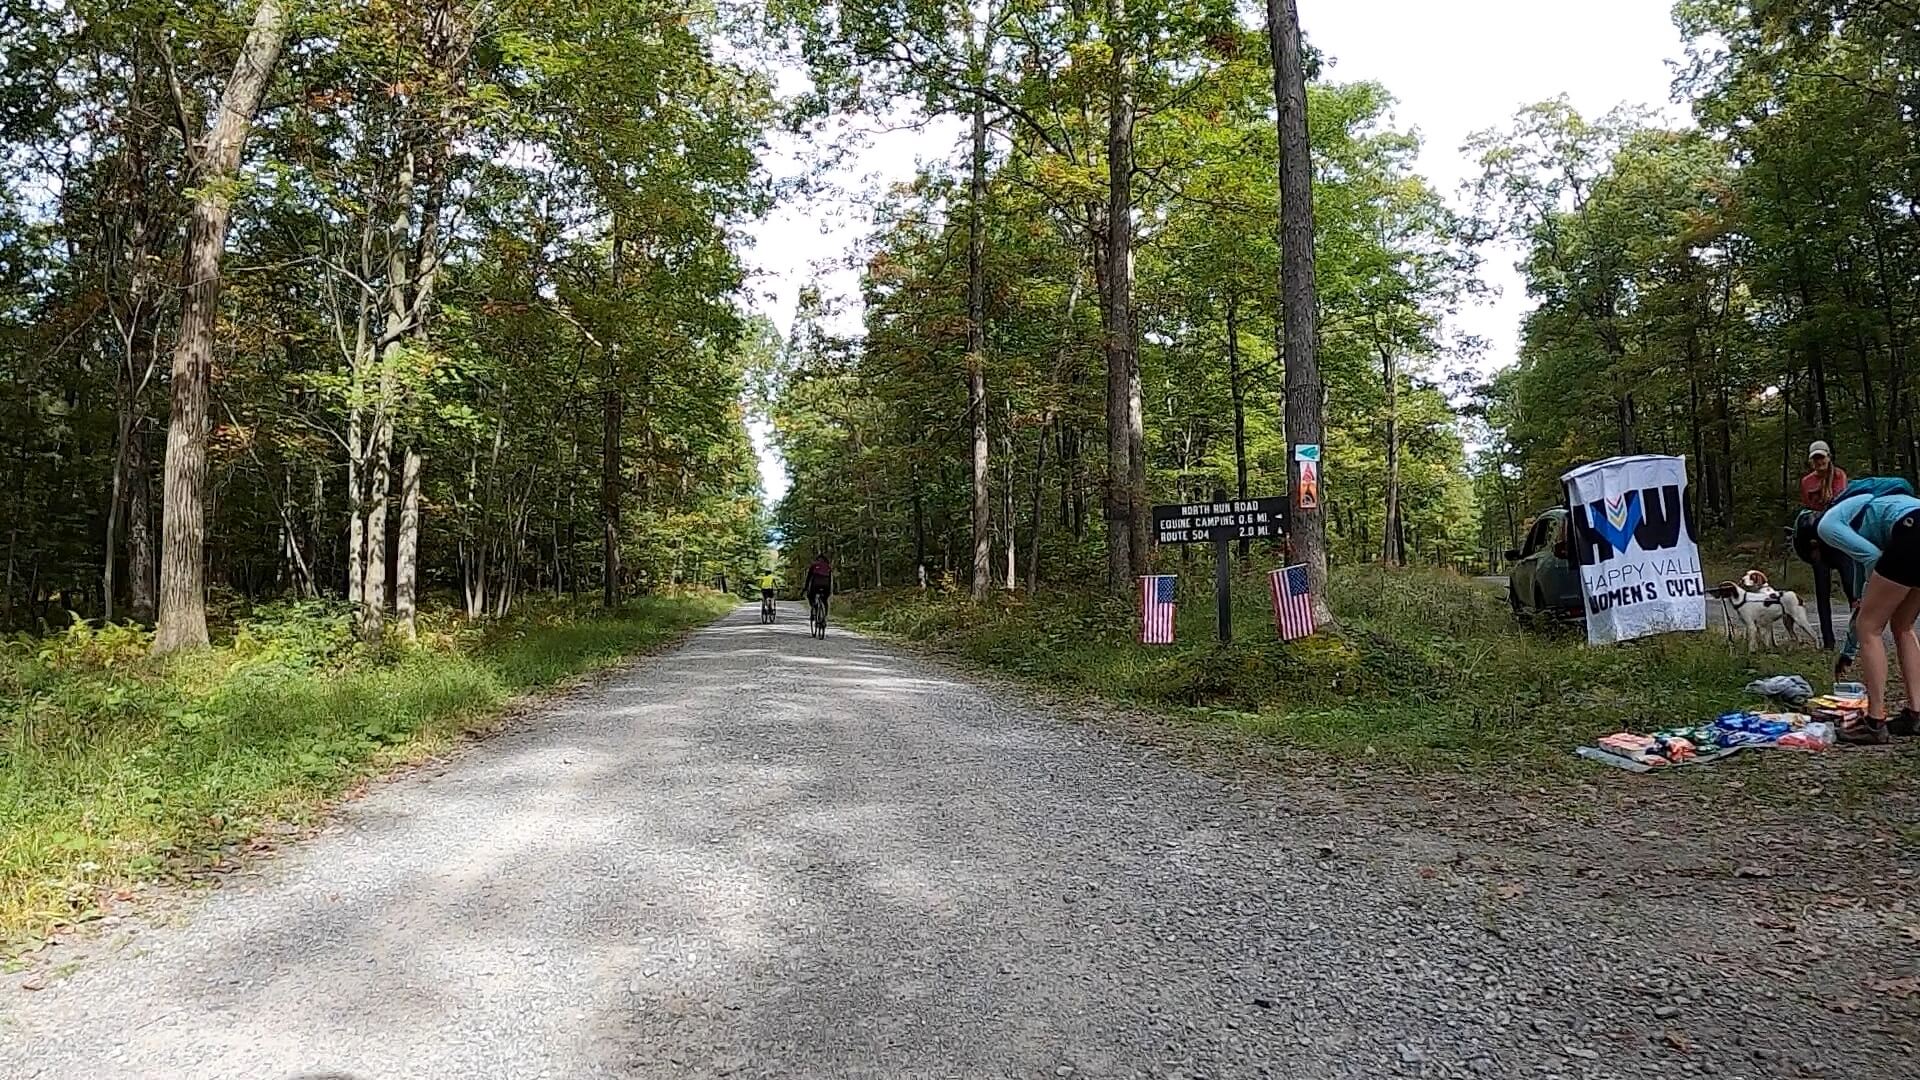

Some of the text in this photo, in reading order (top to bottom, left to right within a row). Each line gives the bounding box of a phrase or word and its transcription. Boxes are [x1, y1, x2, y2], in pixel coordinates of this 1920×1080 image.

[1181, 501, 1259, 516] NORTH RUN ROAD
[1160, 512, 1270, 530] EQUINE CAMPING 0.6 MI.
[1160, 525, 1271, 542] ROUTE 504 2.0 MI.
